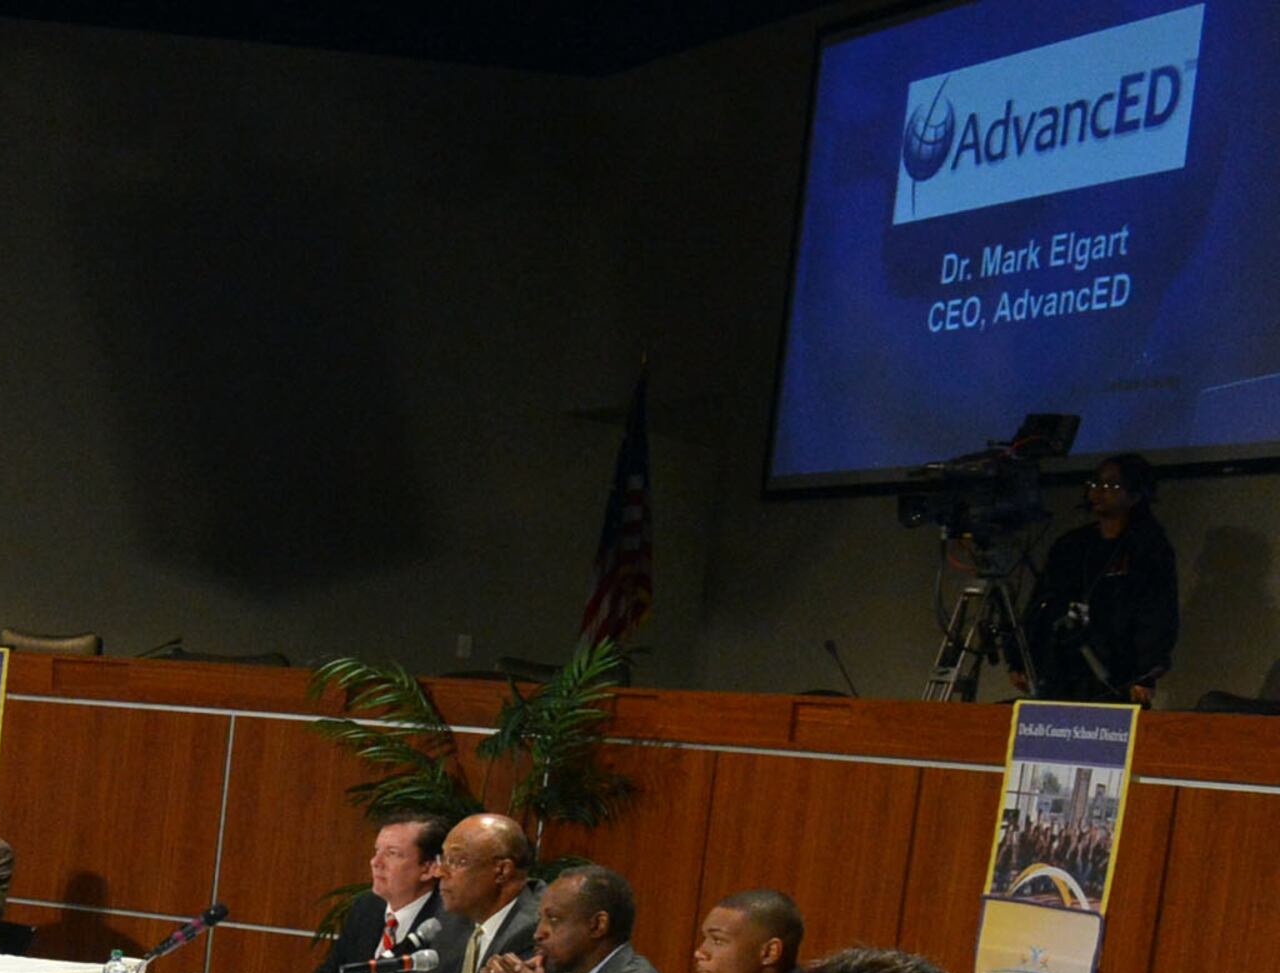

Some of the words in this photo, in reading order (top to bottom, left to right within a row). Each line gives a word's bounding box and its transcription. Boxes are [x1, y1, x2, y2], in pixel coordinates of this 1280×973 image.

[950, 64, 1182, 171] AdvancED
[940, 253, 972, 284] Dr.
[980, 240, 1041, 278] Mark
[1049, 223, 1130, 271] Elgart
[927, 296, 986, 332] CEO,
[992, 273, 1132, 324] AdvancED
[1019, 722, 1045, 736] DeKalb
[1045, 724, 1071, 741] County
[1072, 726, 1099, 740] School
[1099, 728, 1128, 742] District
